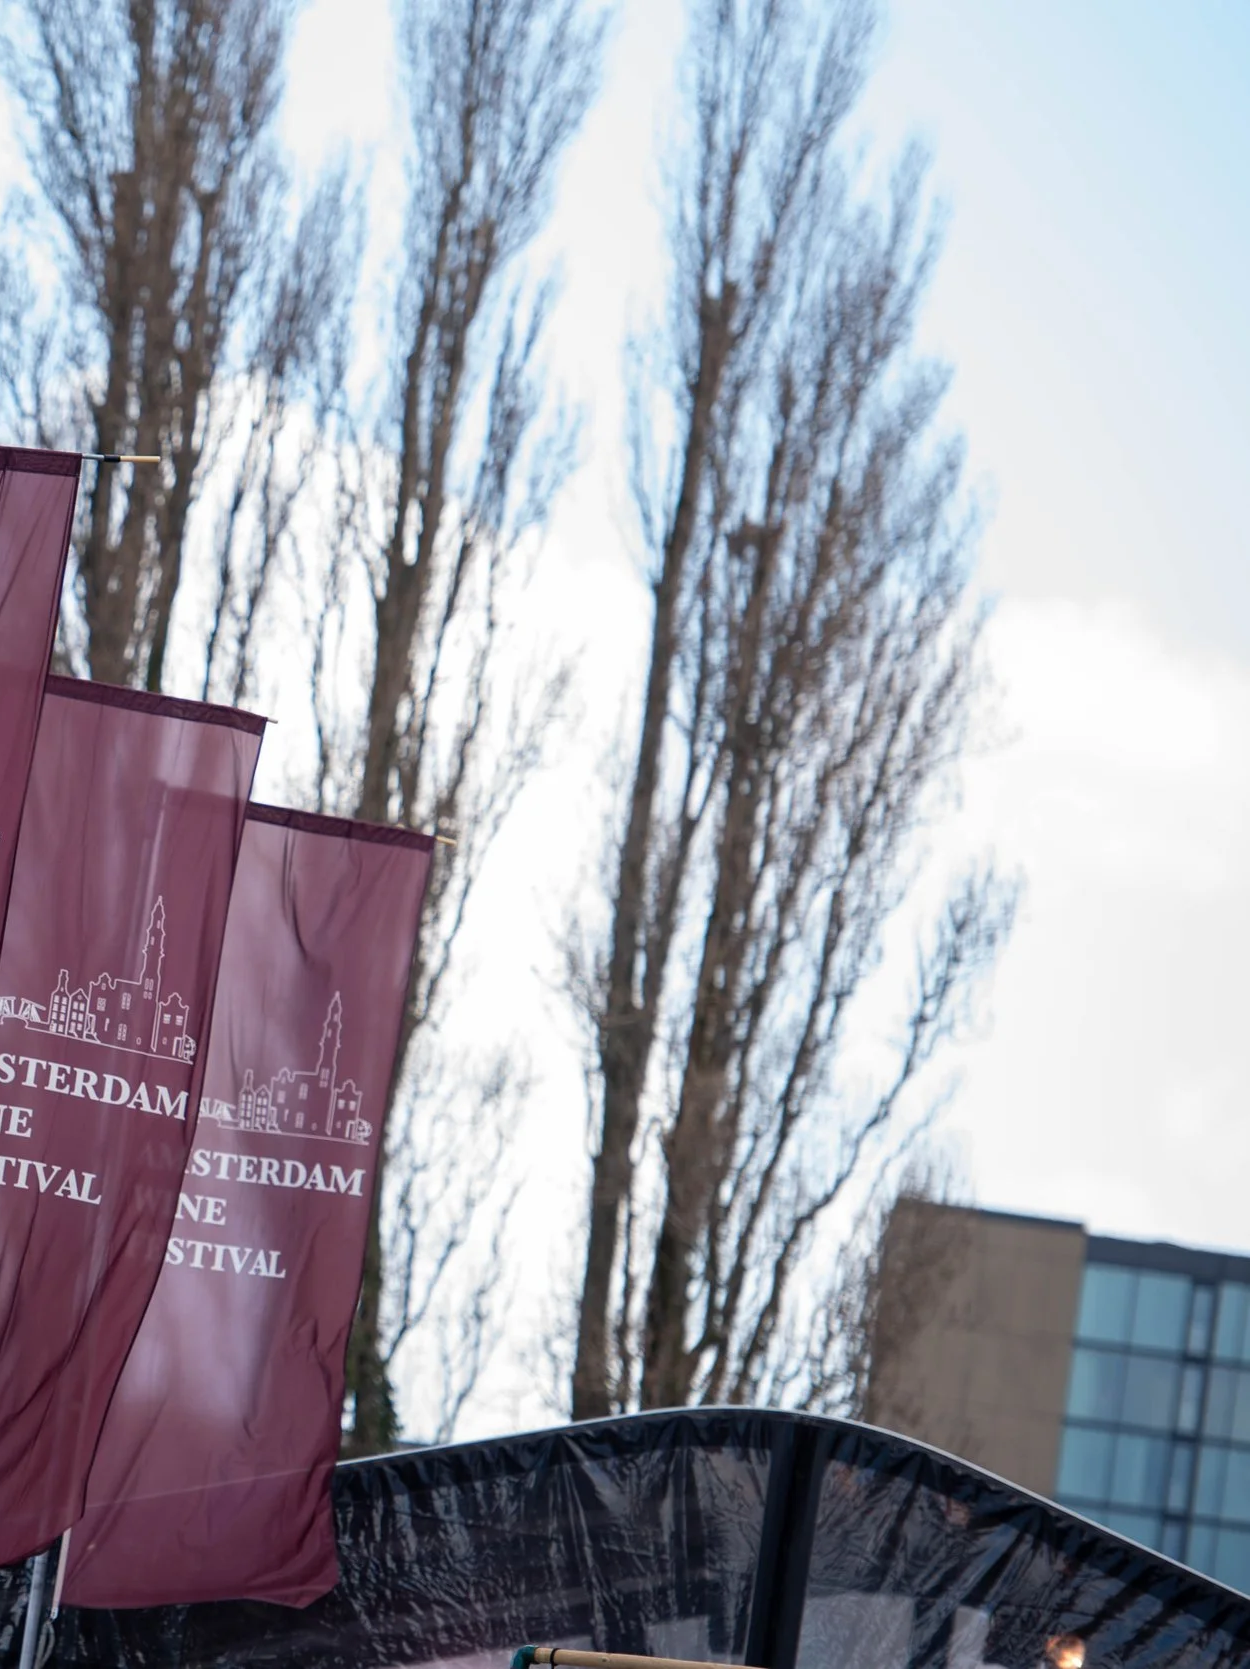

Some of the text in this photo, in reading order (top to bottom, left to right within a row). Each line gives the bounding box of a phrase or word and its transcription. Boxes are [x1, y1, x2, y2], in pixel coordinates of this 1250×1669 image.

[184, 1148, 366, 1197] STERDAM
[174, 1192, 227, 1226] NE
[165, 1236, 286, 1279] STIVAL
